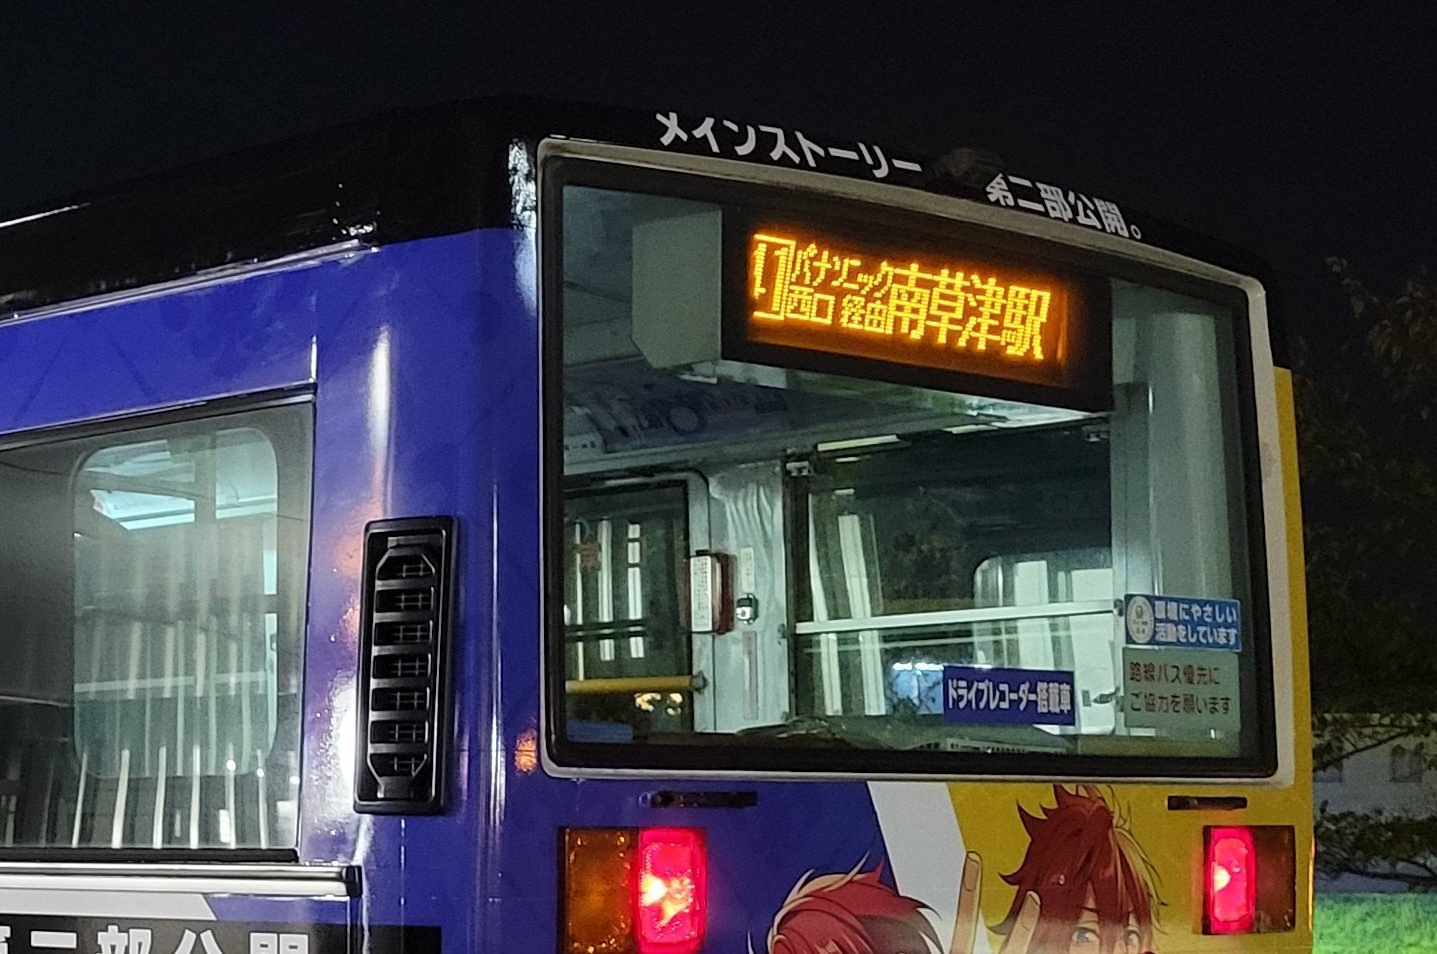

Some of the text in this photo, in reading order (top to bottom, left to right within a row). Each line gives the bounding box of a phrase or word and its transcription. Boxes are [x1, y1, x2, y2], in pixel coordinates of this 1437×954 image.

[655, 110, 923, 180] メインストーリー
[790, 243, 895, 298] パナソニック
[885, 262, 1051, 360] 南草津駅
[1129, 662, 1221, 685] 路線バス優先に
[948, 679, 1072, 714] ドライブレコーダー搭載車
[1129, 692, 1233, 715] ご協力を願います
